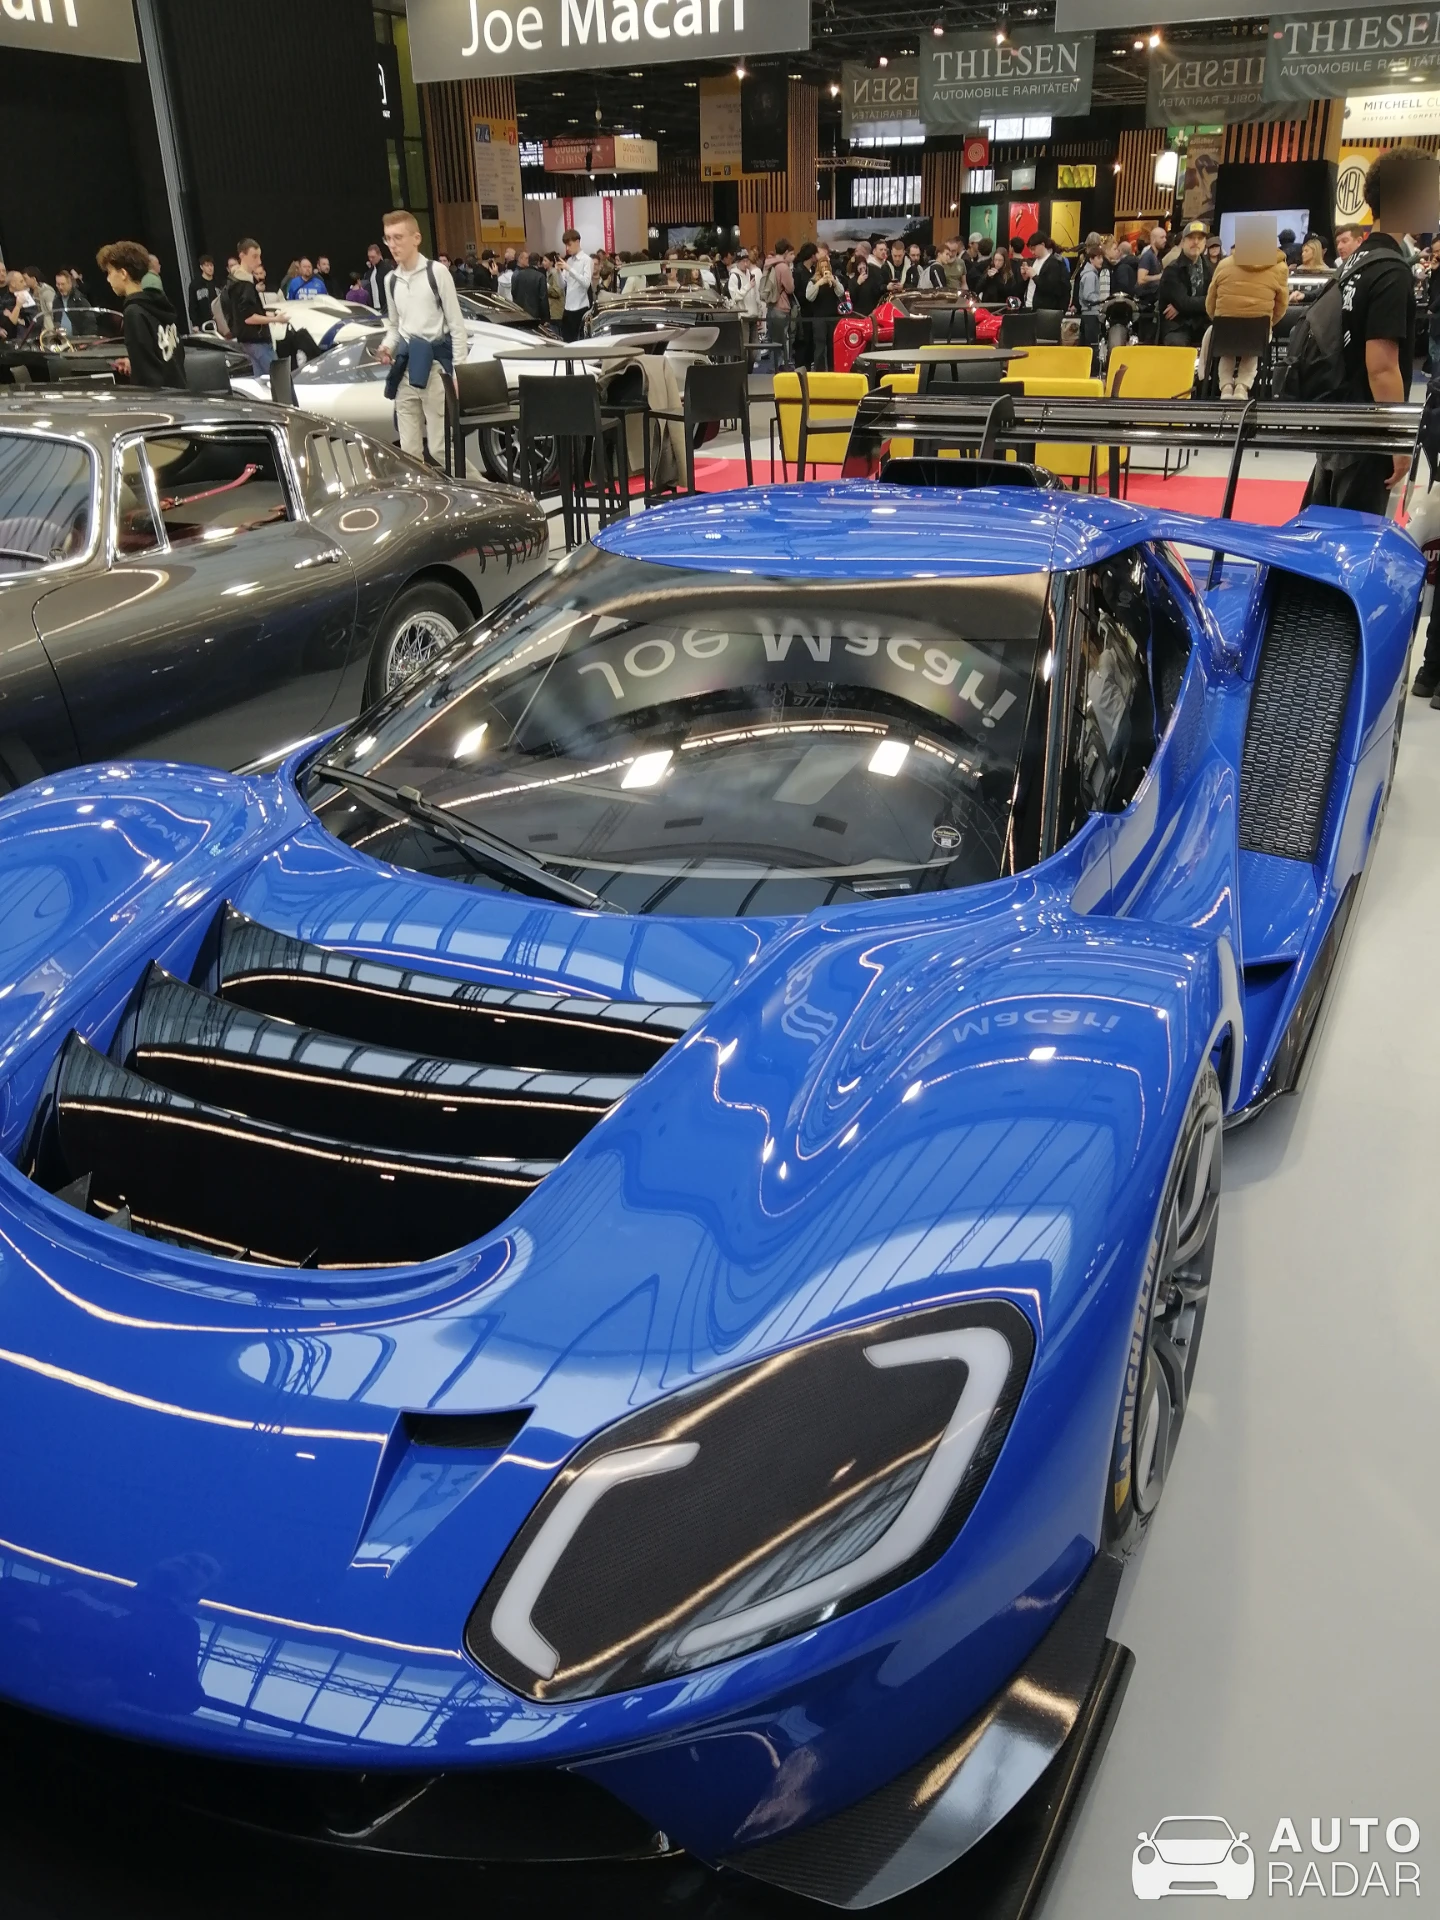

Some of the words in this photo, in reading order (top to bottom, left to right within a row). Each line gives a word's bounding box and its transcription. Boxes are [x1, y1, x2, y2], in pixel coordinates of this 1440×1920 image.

[462, 0, 543, 56] Joe
[1284, 11, 1440, 54] THIESE
[932, 42, 1081, 81] THIESEN
[1280, 60, 1372, 76] AUTOMOBILE
[932, 86, 1009, 101] AUTOMOBILE
[1013, 82, 1079, 96] RARITÄTEN
[1364, 99, 1422, 111] MITCHELL
